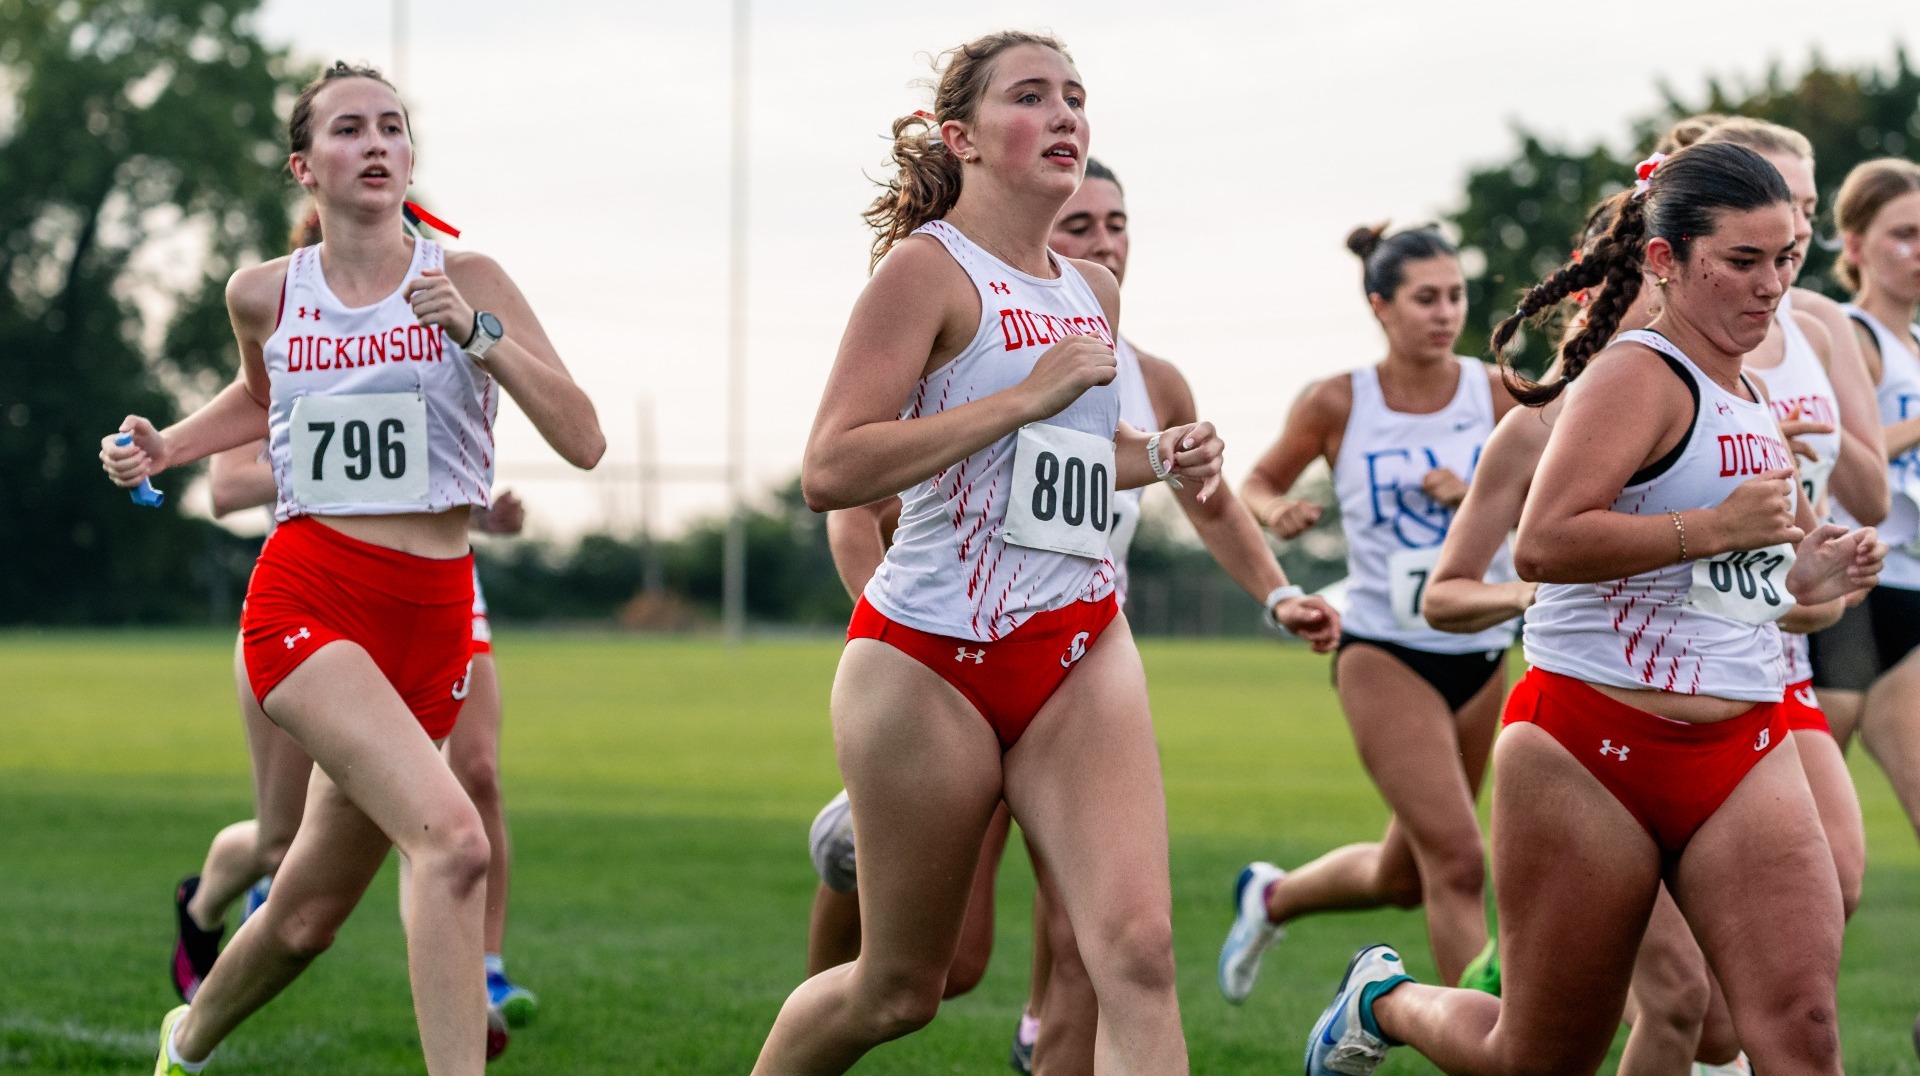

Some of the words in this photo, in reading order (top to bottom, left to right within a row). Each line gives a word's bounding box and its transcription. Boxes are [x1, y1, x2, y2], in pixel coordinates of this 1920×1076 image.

[287, 325, 444, 372] DICKINSON
[307, 418, 407, 481] 796
[1031, 451, 1108, 532] 800
